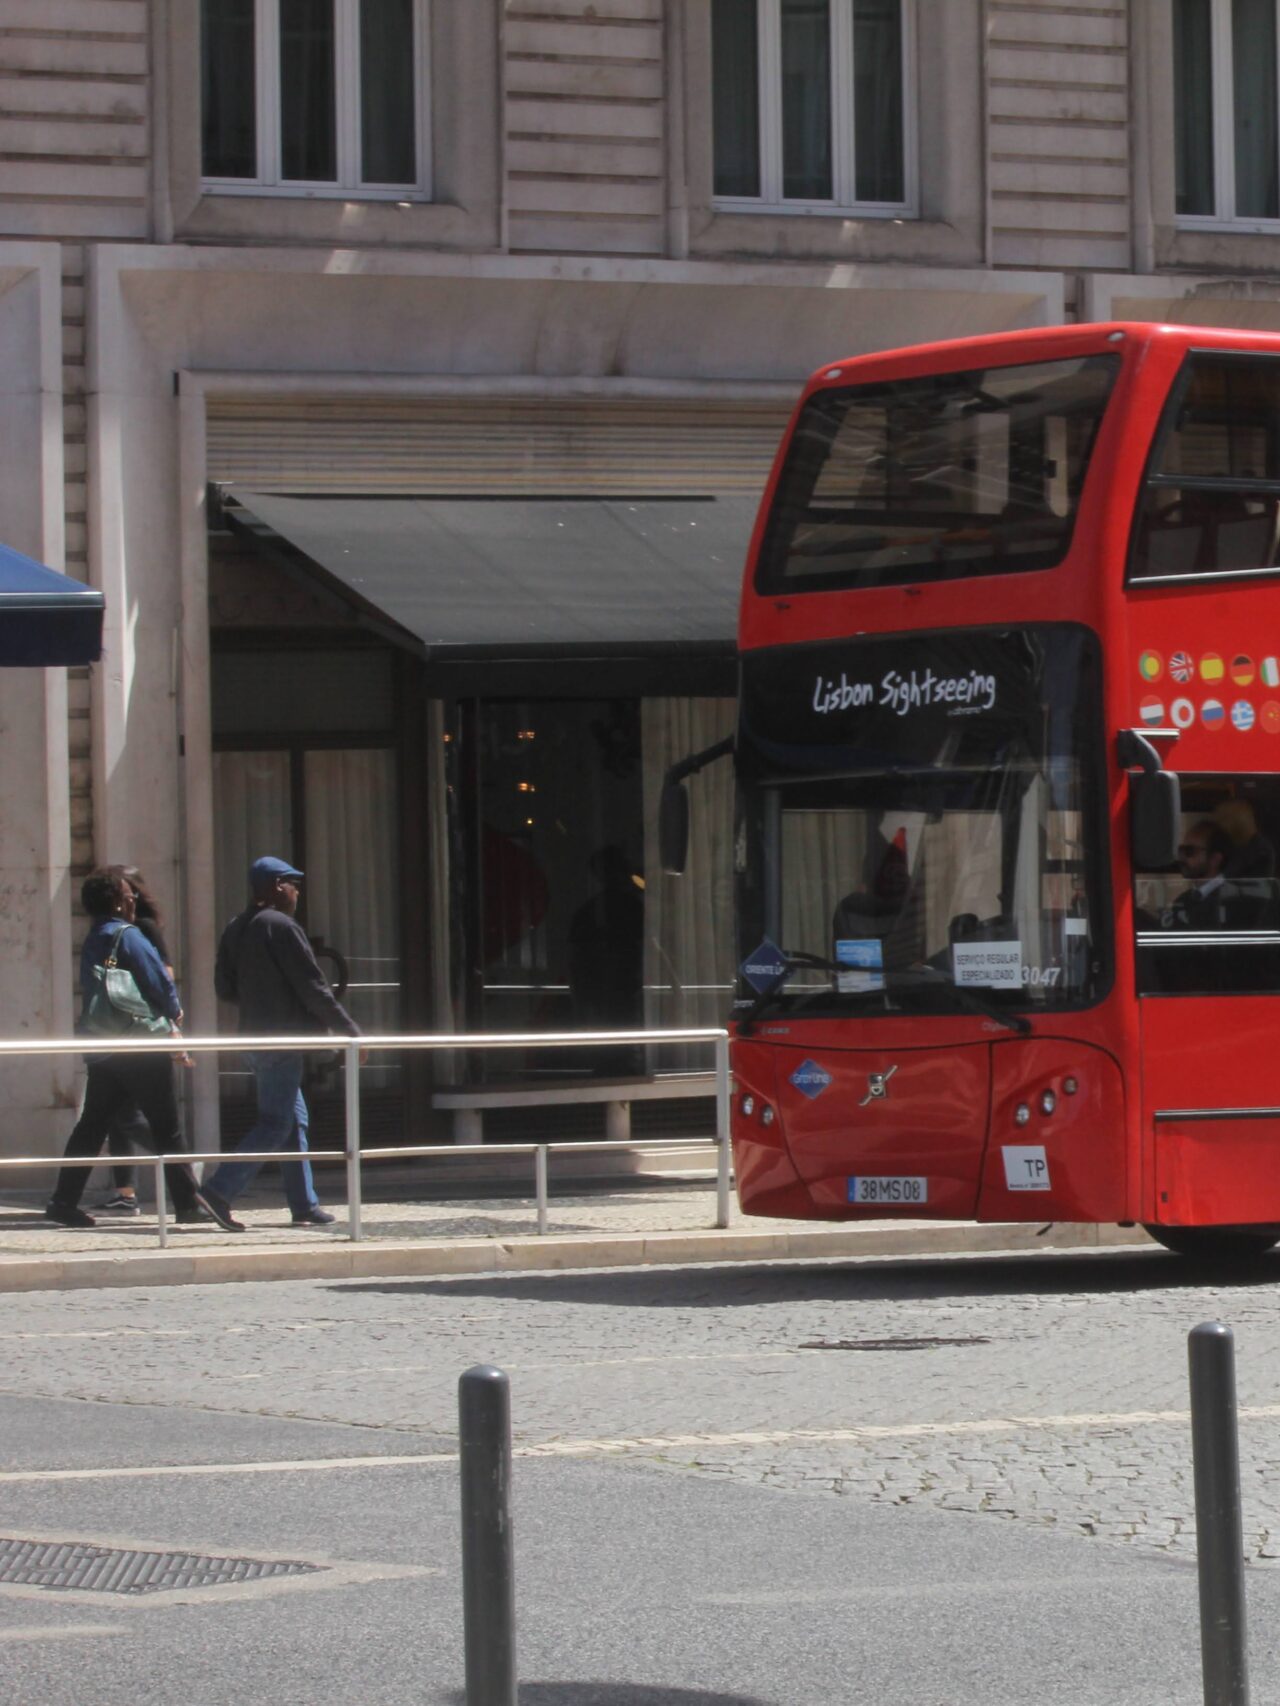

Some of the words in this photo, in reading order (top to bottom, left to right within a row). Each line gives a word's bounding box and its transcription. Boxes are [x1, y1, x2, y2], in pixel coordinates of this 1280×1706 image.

[813, 674, 874, 713] Lisbon
[879, 668, 996, 715] Sightseeing
[1021, 966, 1061, 986] 3047
[1023, 1159, 1046, 1178] TP
